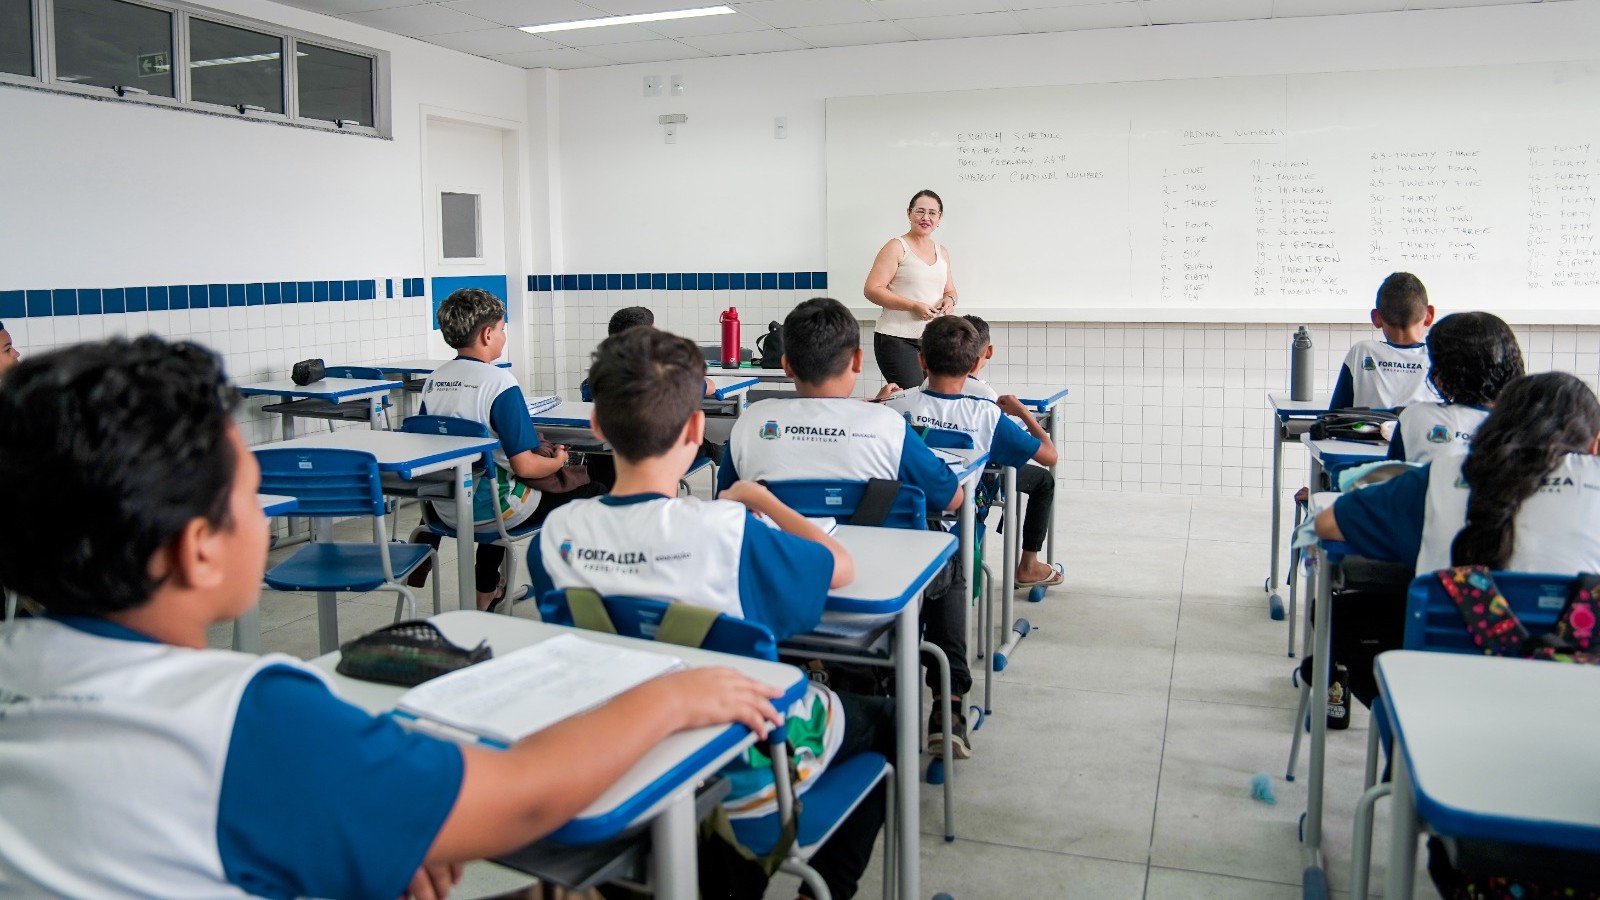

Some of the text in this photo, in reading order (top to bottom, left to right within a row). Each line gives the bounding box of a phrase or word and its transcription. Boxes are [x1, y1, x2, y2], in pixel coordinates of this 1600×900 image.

[957, 131, 1002, 143] ENGLISH
[957, 146, 1000, 154] TEACHER
[1394, 151, 1437, 162] TWENTY
[1182, 166, 1207, 175] ONE
[1448, 165, 1478, 175] FOUR
[1009, 170, 1058, 183] CARDINAL
[1066, 171, 1104, 180] NUMBERS
[1185, 183, 1207, 191] TWO
[1398, 179, 1448, 189] TWENTY
[1400, 193, 1438, 203] THIRTY
[1184, 199, 1218, 208] THREE
[1402, 206, 1438, 216] THIRTY
[1185, 220, 1214, 231] FOUR
[1402, 227, 1447, 237] THIRTY
[1453, 226, 1495, 236] THREE
[1185, 235, 1208, 244] FIVE
[1397, 241, 1437, 250] THIRTY
[1448, 241, 1476, 250] FOUR
[1183, 248, 1201, 260] SIX
[1184, 261, 1213, 272] SEVEN
[1281, 265, 1324, 276] TWENTY
[1378, 361, 1422, 370] FORTALEZA
[917, 415, 959, 431] FORTALEZA
[784, 425, 846, 437] FORTALEZA
[577, 548, 648, 565] FORTALEZA
